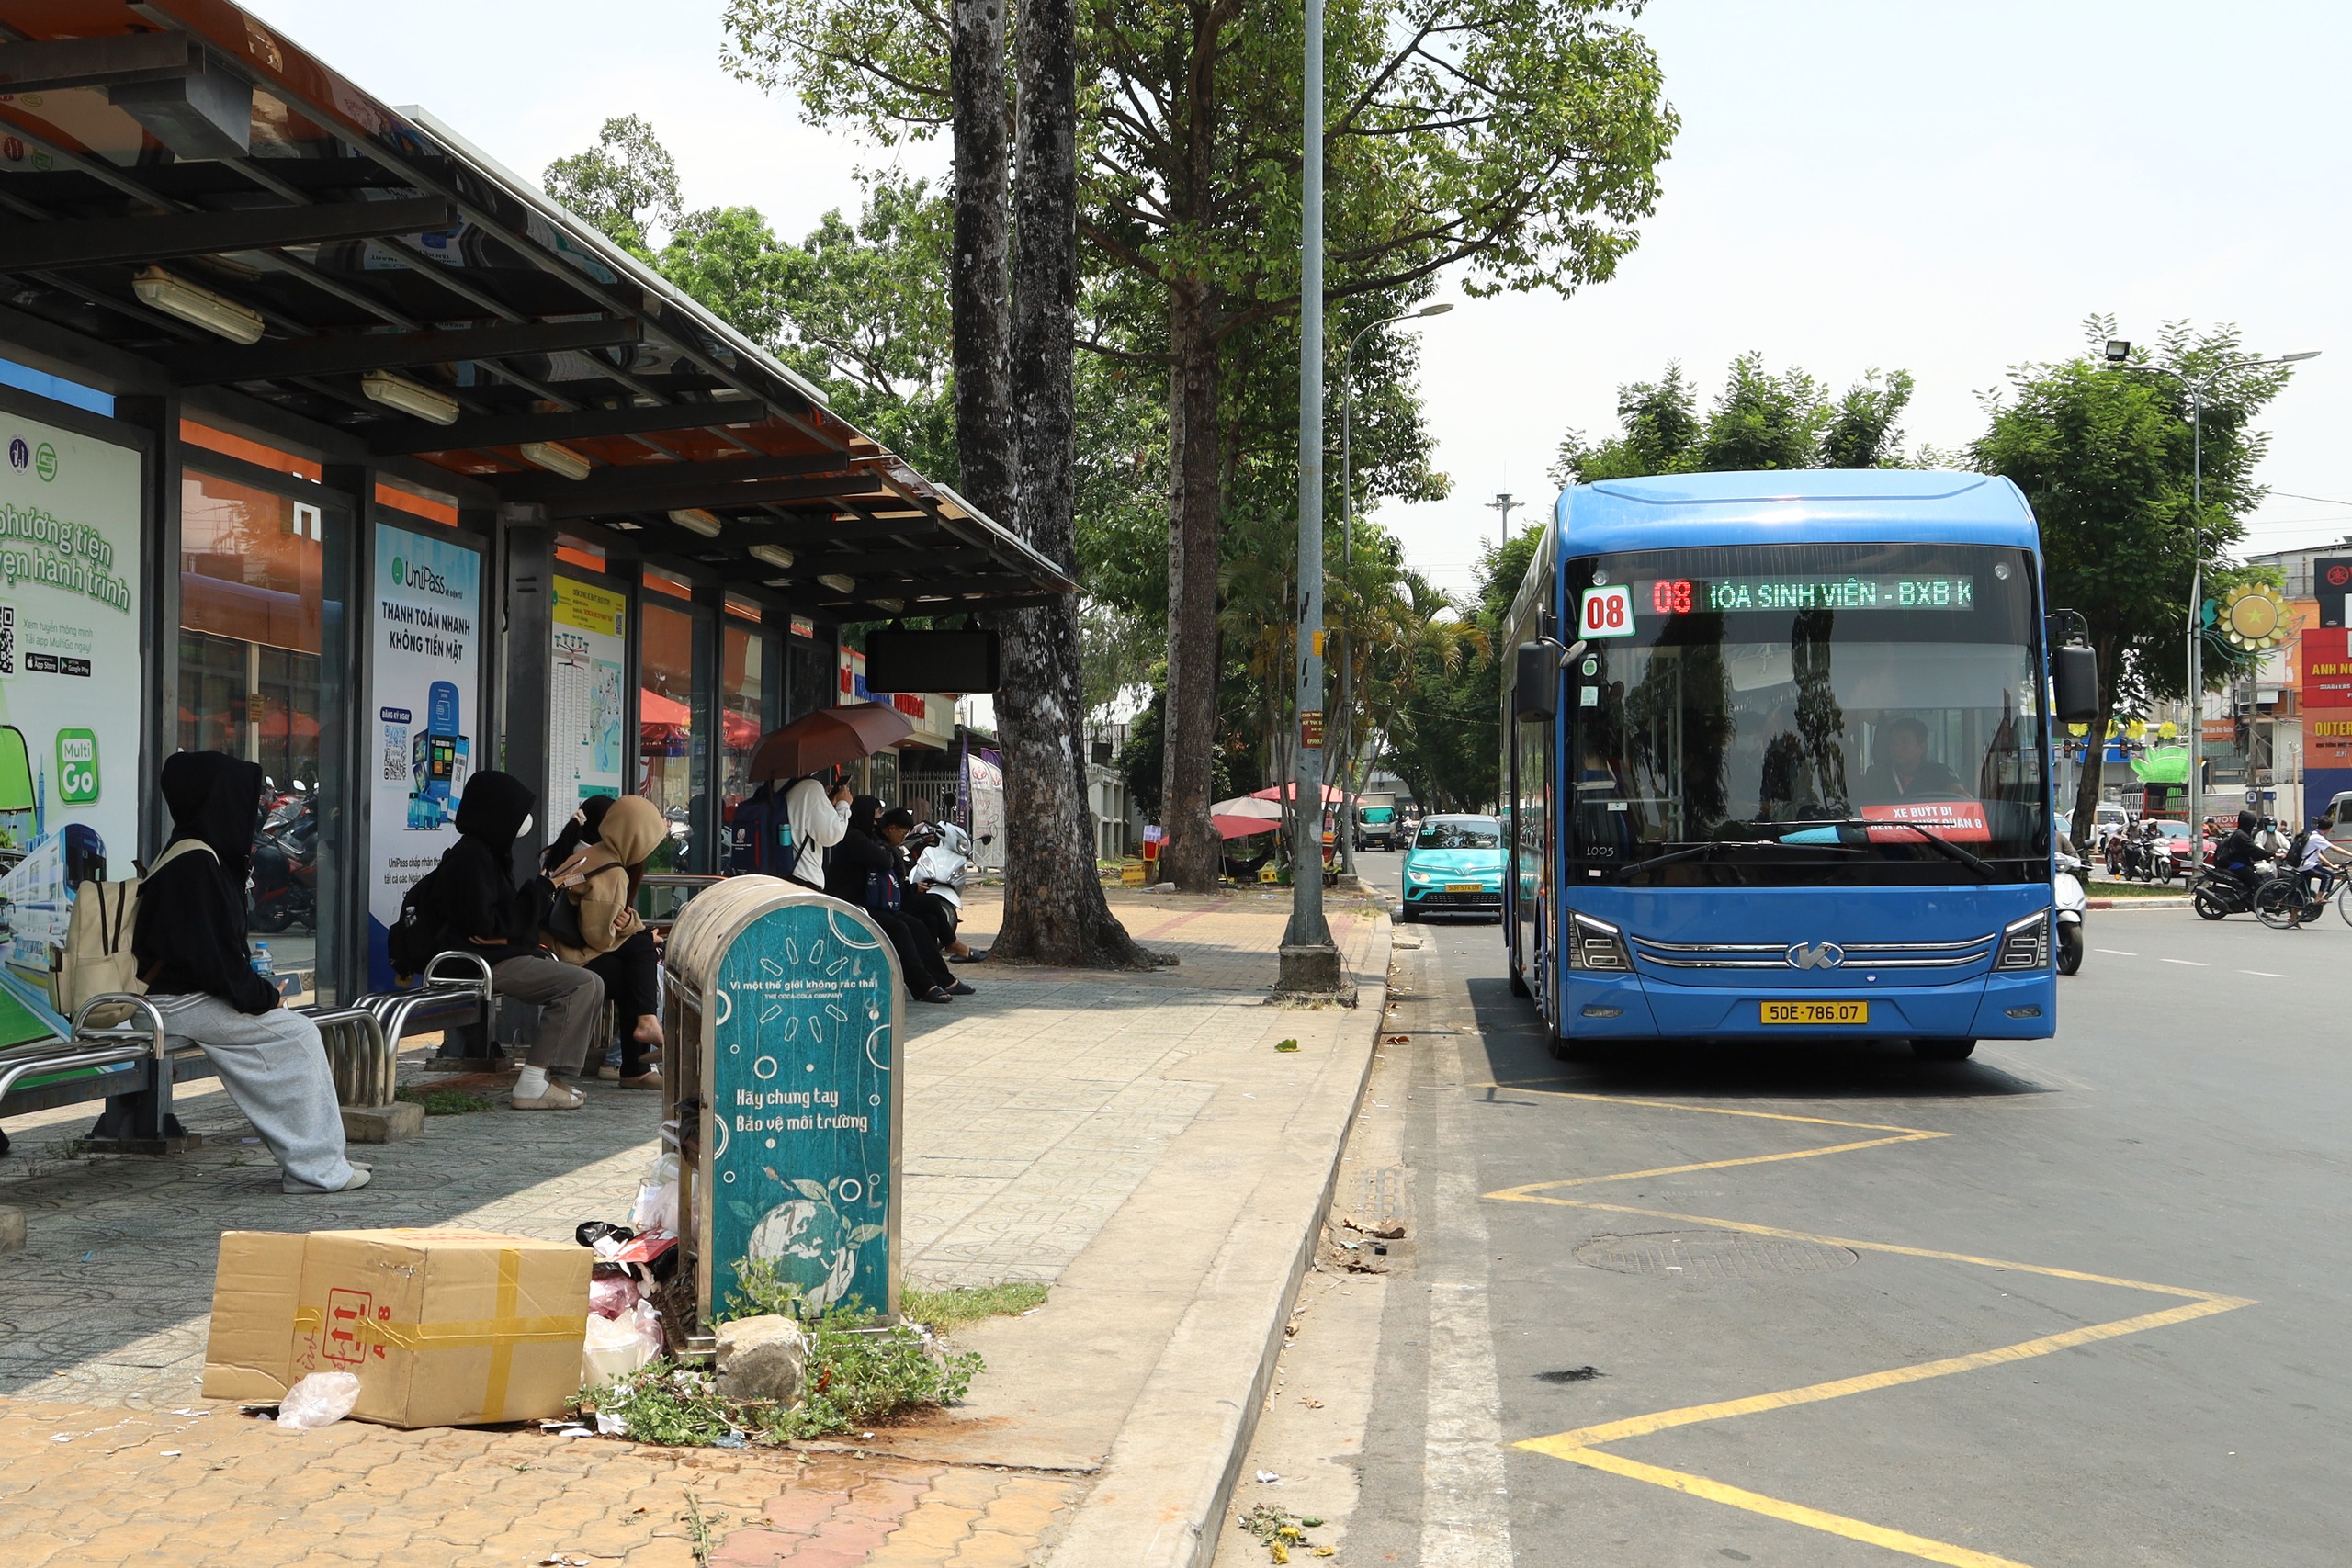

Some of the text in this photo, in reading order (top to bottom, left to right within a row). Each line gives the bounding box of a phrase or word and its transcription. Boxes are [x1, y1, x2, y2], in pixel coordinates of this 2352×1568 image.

[76, 524, 112, 567] tiện
[0, 547, 130, 610] ẹn hành trình
[406, 561, 444, 595] UniPass
[1654, 580, 1691, 613] 08
[1758, 583, 1815, 608] SINH
[1821, 578, 1876, 607] VIÊN
[1898, 581, 1950, 605] BXB
[382, 602, 469, 636] THANH TOÁN NHANH
[1587, 595, 1624, 630] 08
[390, 629, 422, 653] KHÔNG
[446, 639, 463, 664] MẶT
[2312, 664, 2336, 675] ANH
[64, 742, 91, 758] Multi
[62, 763, 94, 794] Go
[1893, 805, 1953, 818] XE BUÝT ĐI
[1942, 817, 1973, 830] QUẬN
[1975, 818, 1983, 829] 8
[389, 857, 408, 868] UniPass
[730, 981, 741, 990] Vì
[743, 980, 763, 991] một
[765, 978, 782, 990] thế
[785, 980, 803, 991] giới
[806, 979, 837, 991] không
[840, 979, 856, 989] rác
[1770, 1006, 1859, 1020] 50E-786.07
[736, 1087, 839, 1110] Hãy chung tay
[736, 1113, 868, 1133] Bảo vệ môi trường
